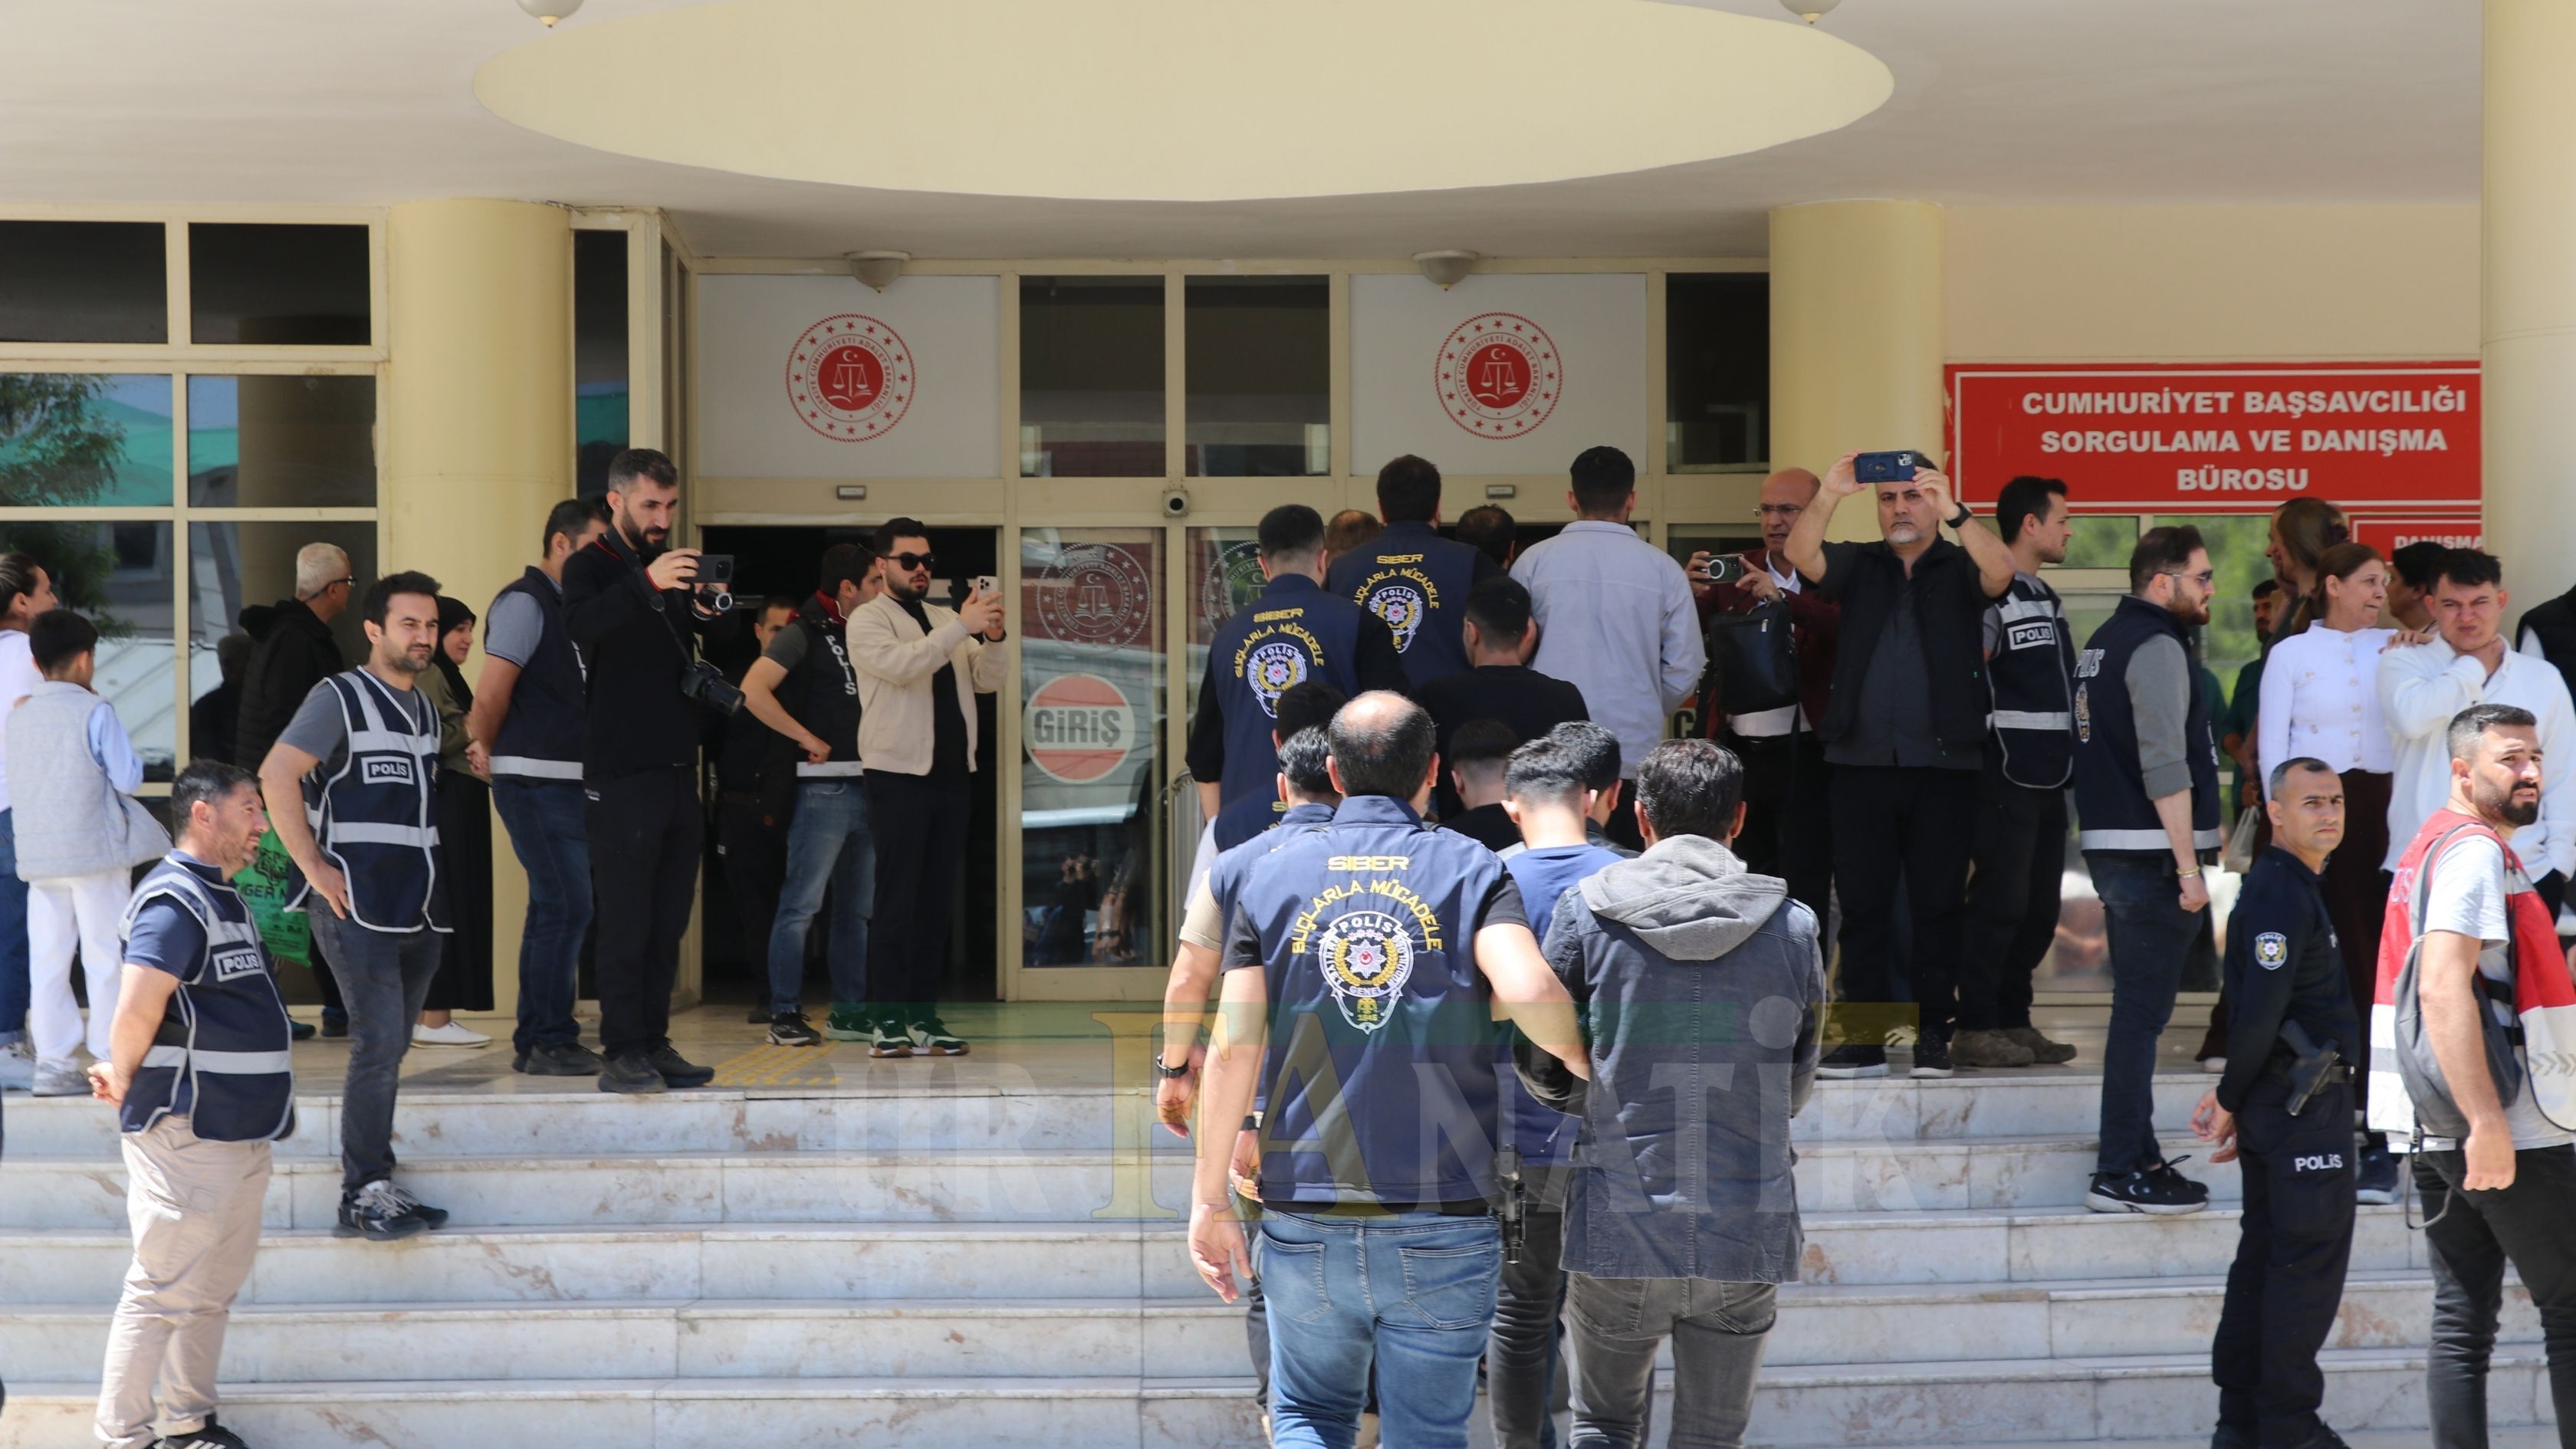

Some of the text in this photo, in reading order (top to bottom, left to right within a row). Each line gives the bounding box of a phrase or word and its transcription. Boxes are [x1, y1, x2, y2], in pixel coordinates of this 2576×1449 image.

[2022, 385, 2466, 419] CUMHURİYET BAŞSAVCILIĞI
[2040, 429, 2449, 458] SORGULAMA VE DANIŞMA
[2177, 464, 2309, 491] BÜROSU
[1353, 567, 1440, 609] UÇLARLA MÜCADELE
[1278, 622, 1325, 667] MÜCADELE
[1338, 915, 1394, 934] POLİS
[1369, 879, 1444, 951] MÜCADELE
